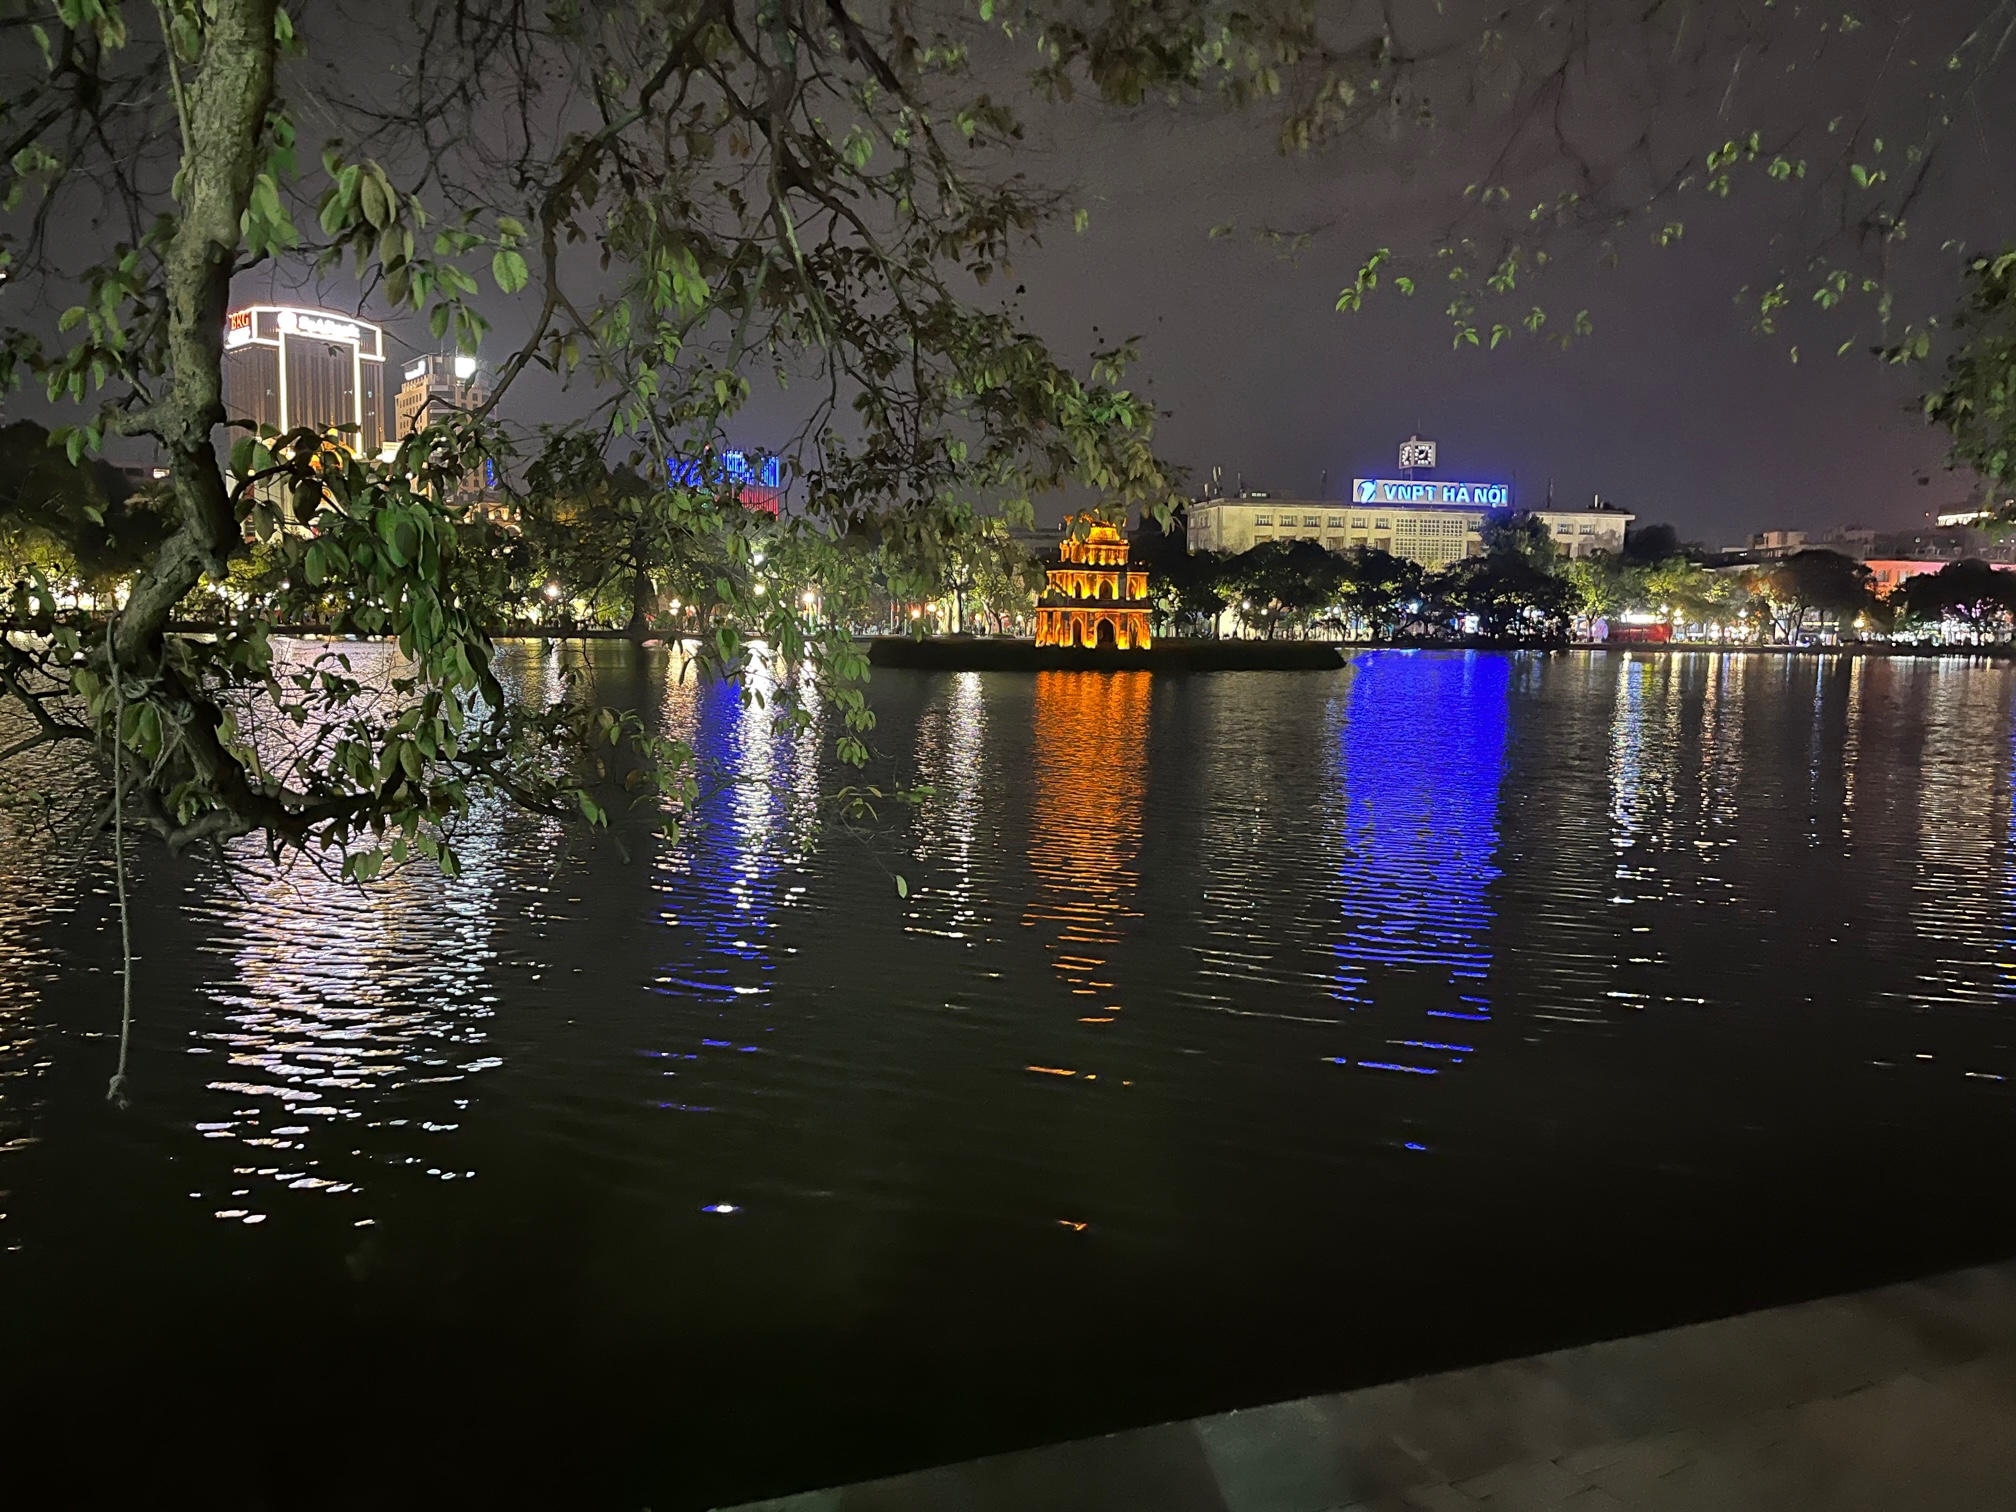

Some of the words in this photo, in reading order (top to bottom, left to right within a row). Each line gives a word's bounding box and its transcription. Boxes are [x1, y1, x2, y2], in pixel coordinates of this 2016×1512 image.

[1383, 484, 1437, 502] VNPT
[1443, 482, 1470, 504] HÀ
[1473, 484, 1507, 508] NỘI
